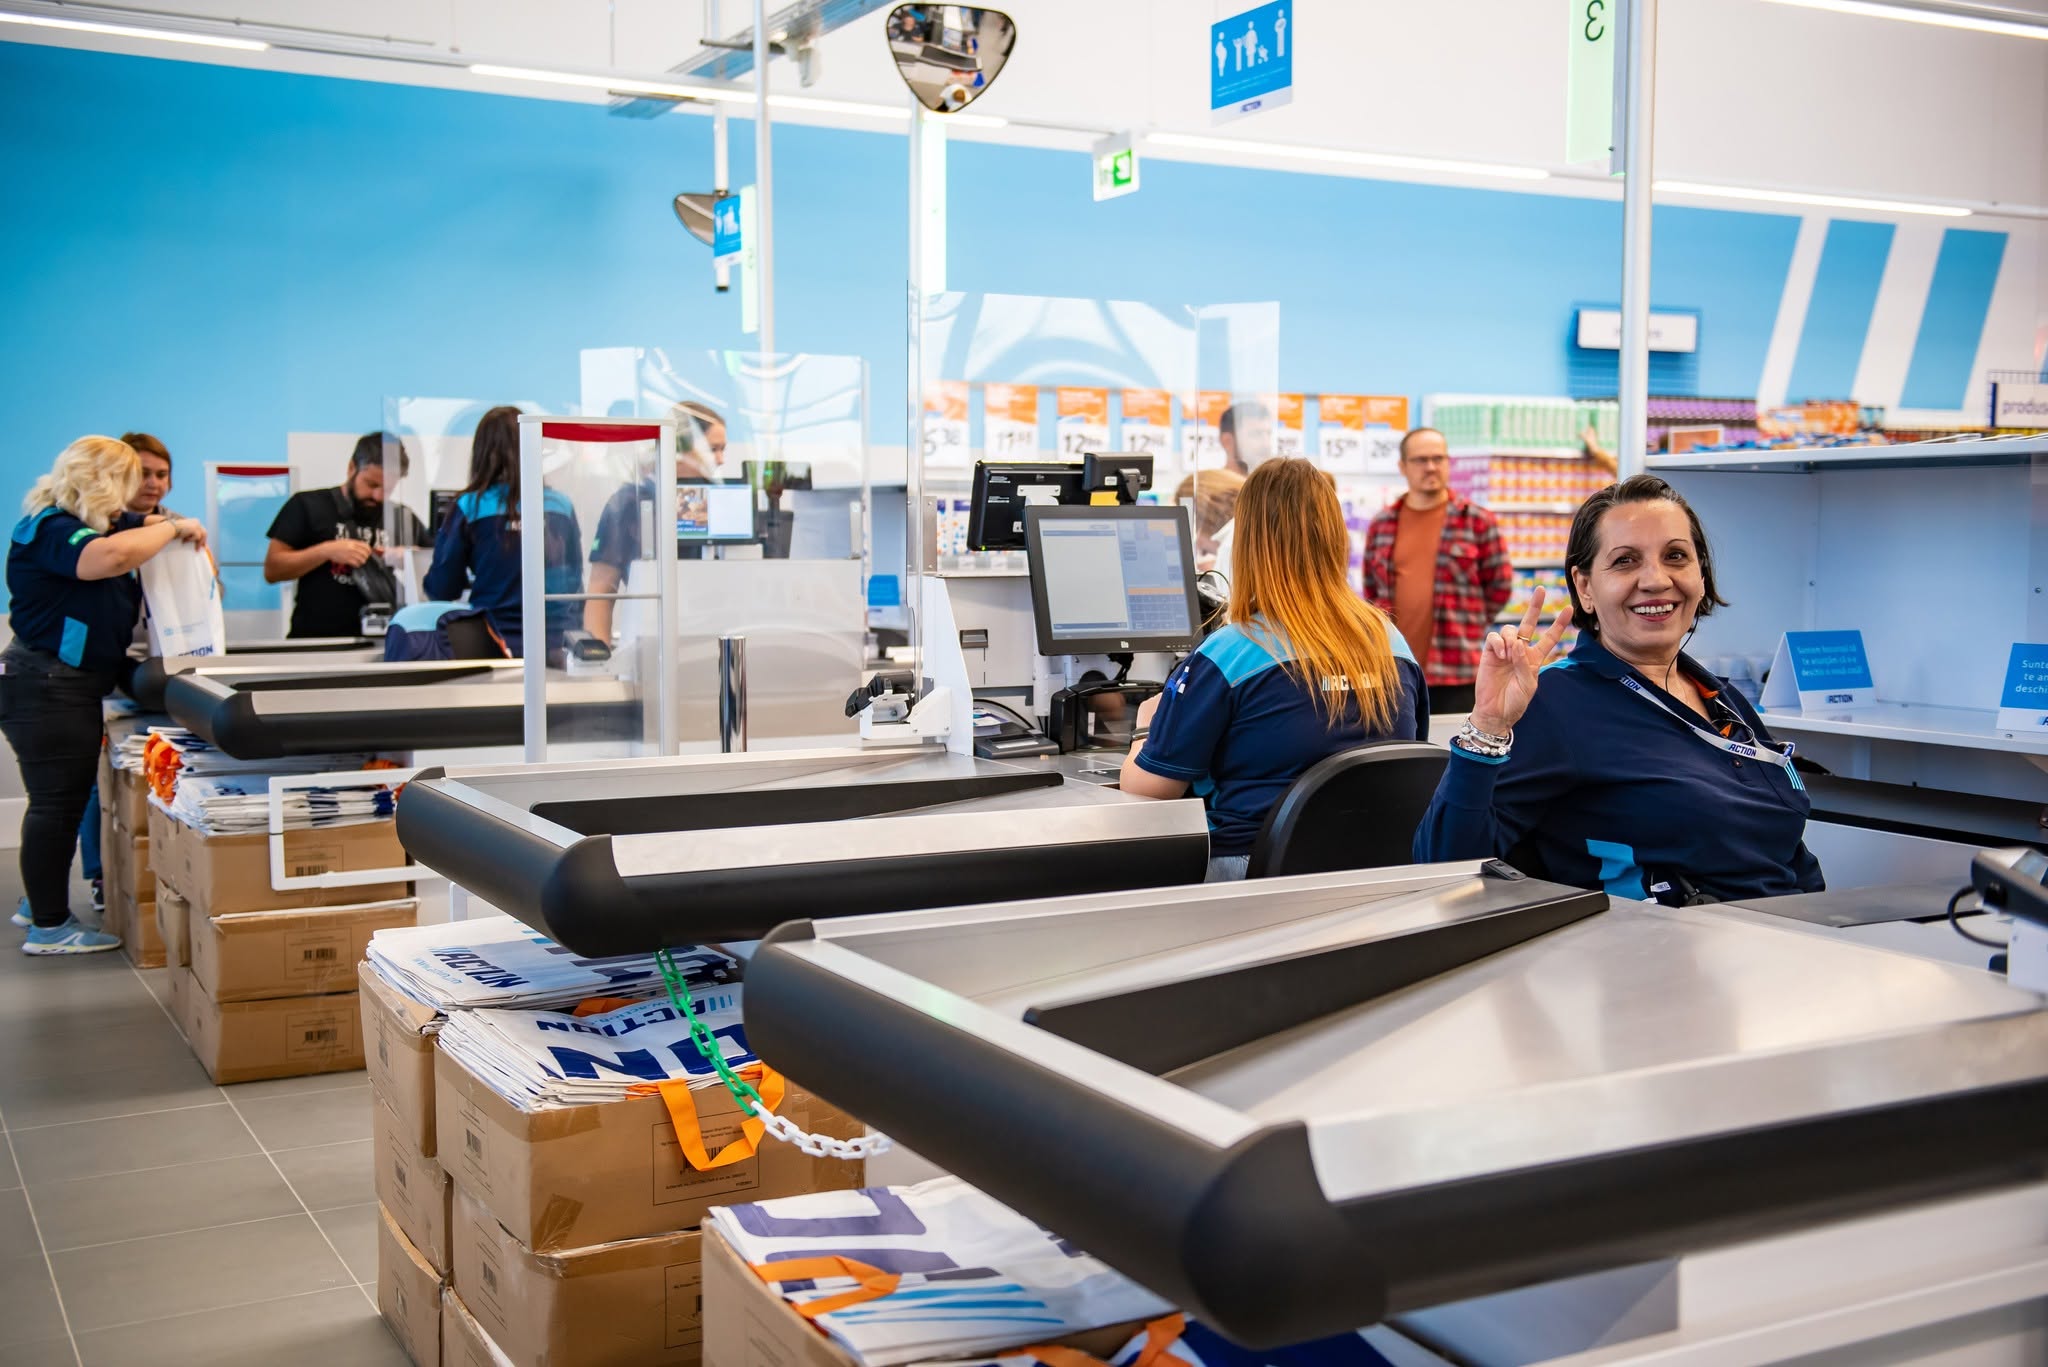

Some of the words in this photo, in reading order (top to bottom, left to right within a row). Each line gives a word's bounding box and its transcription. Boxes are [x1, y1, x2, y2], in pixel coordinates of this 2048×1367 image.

[1827, 694, 1853, 703] ACTION
[1728, 743, 1757, 757] ACTION
[433, 953, 531, 988] ACTION
[536, 999, 706, 1038] ACTION
